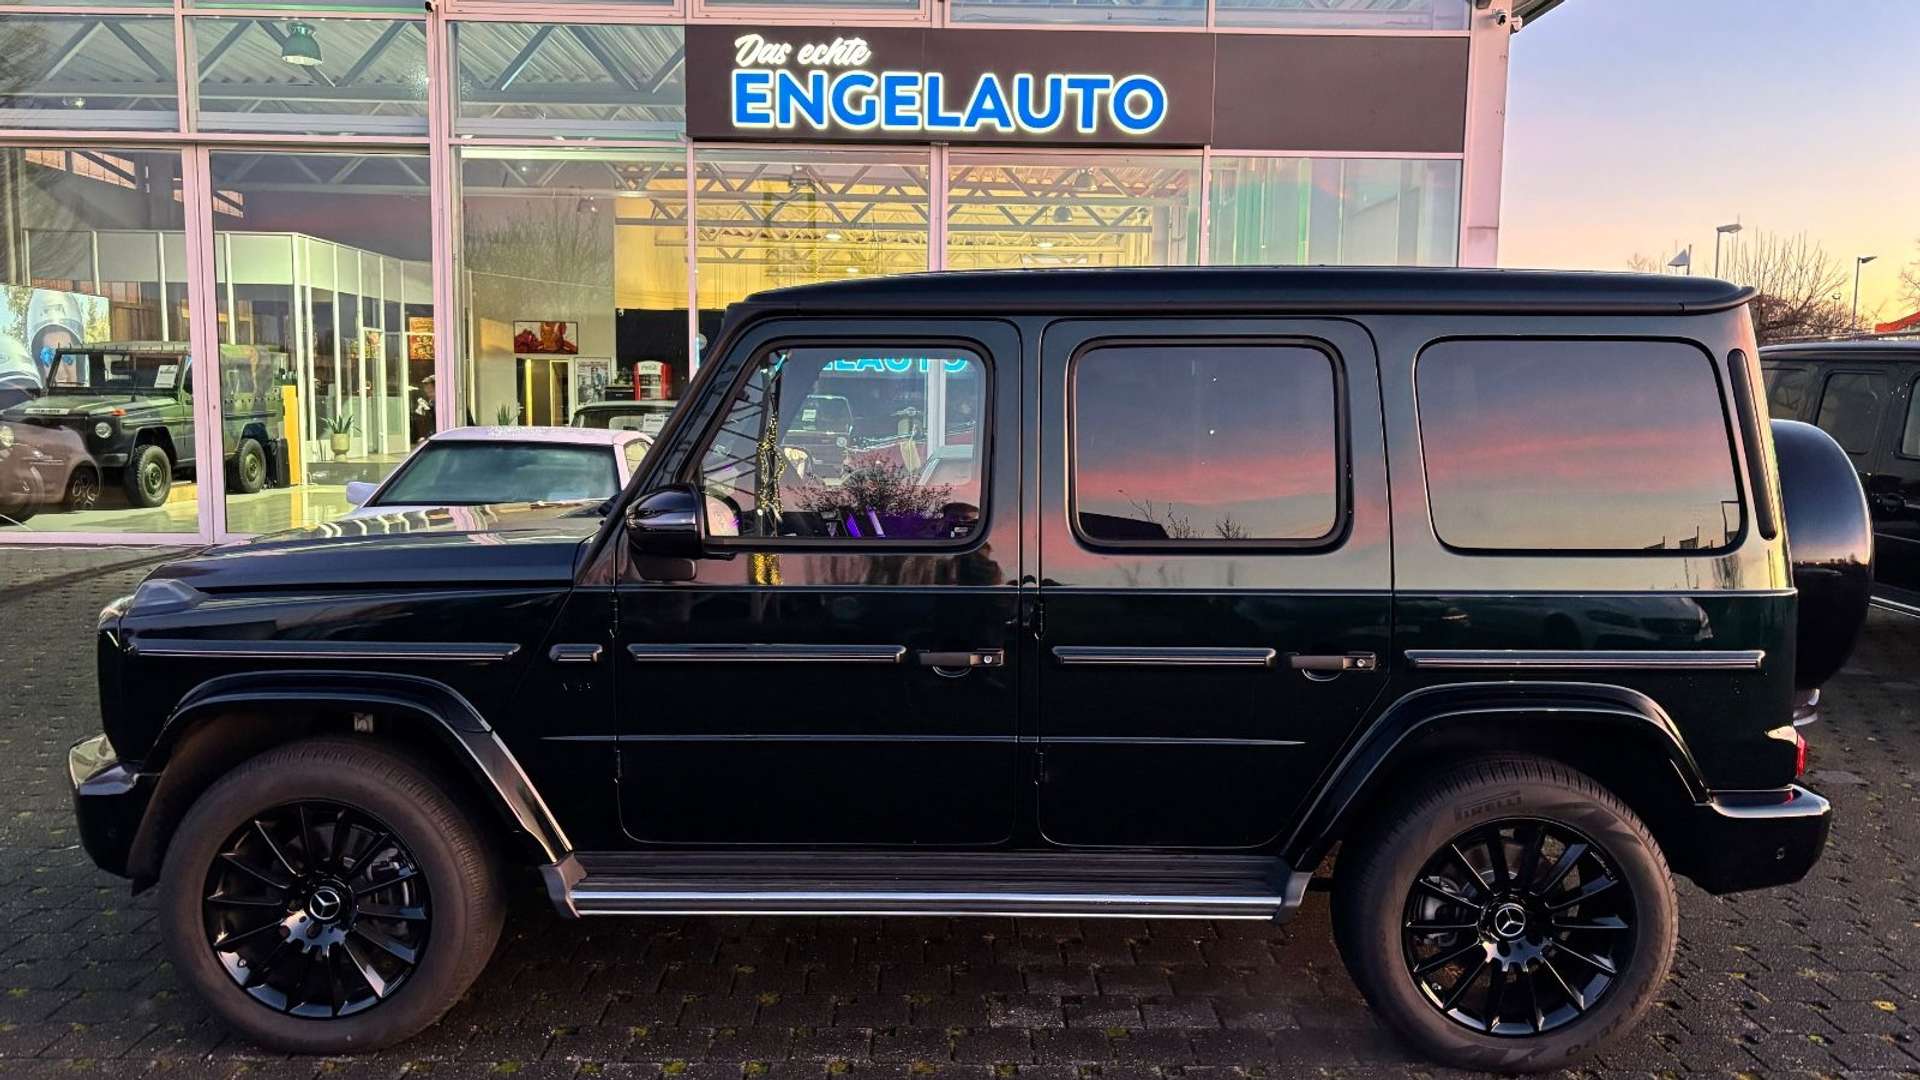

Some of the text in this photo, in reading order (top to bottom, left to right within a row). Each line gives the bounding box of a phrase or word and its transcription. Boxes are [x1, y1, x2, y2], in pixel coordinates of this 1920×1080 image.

[734, 33, 872, 67] Das echte
[733, 70, 1167, 133] ENGELAUTO
[1454, 791, 1522, 822] PIRELLI
